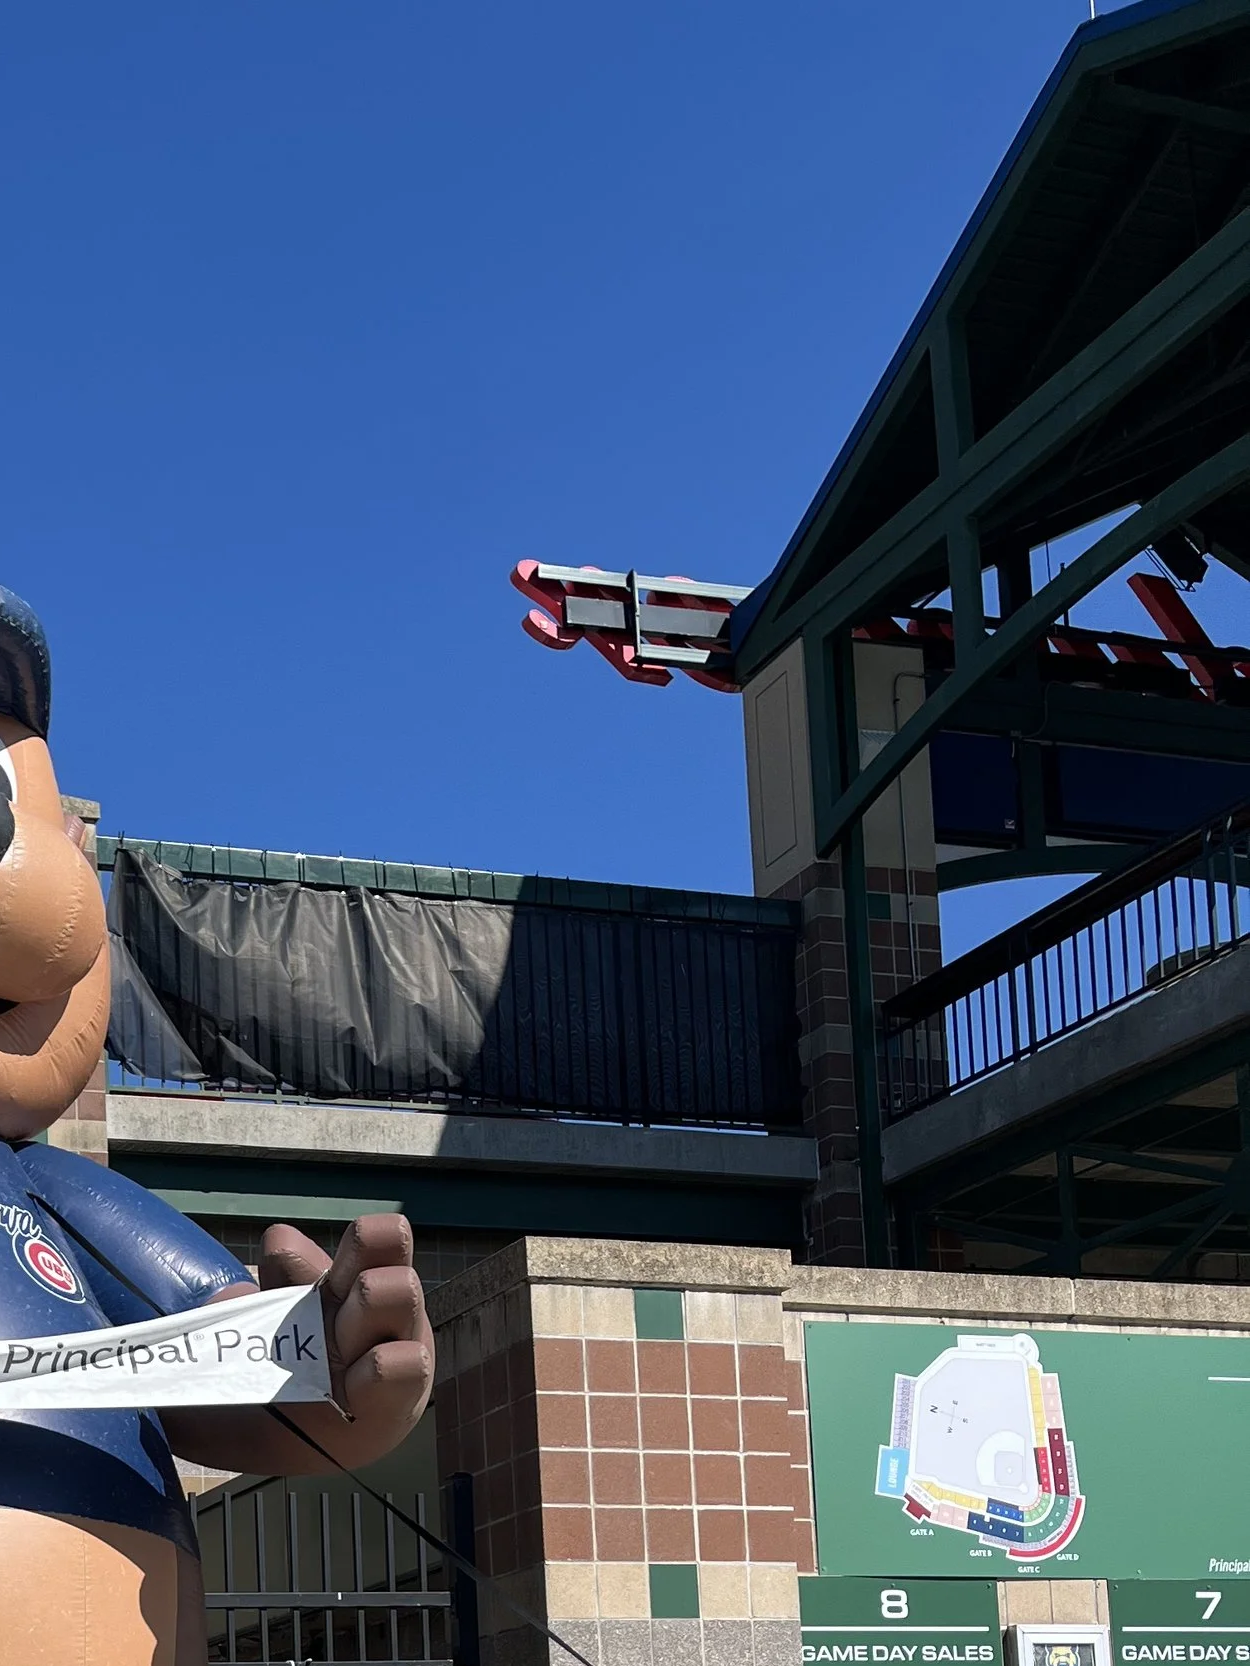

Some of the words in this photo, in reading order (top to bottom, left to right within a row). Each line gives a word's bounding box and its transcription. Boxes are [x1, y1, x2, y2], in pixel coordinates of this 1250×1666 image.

[214, 1324, 318, 1363] Park
[887, 1456, 899, 1489] LOUNGE
[927, 1528, 935, 1536] A
[880, 1589, 909, 1619] 8
[1195, 1591, 1222, 1620] 7
[802, 1645, 868, 1661] GAME
[872, 1645, 918, 1661] DAY
[922, 1645, 994, 1661] SALES
[1122, 1645, 1186, 1661] GAME
[1189, 1645, 1232, 1661] DAY
